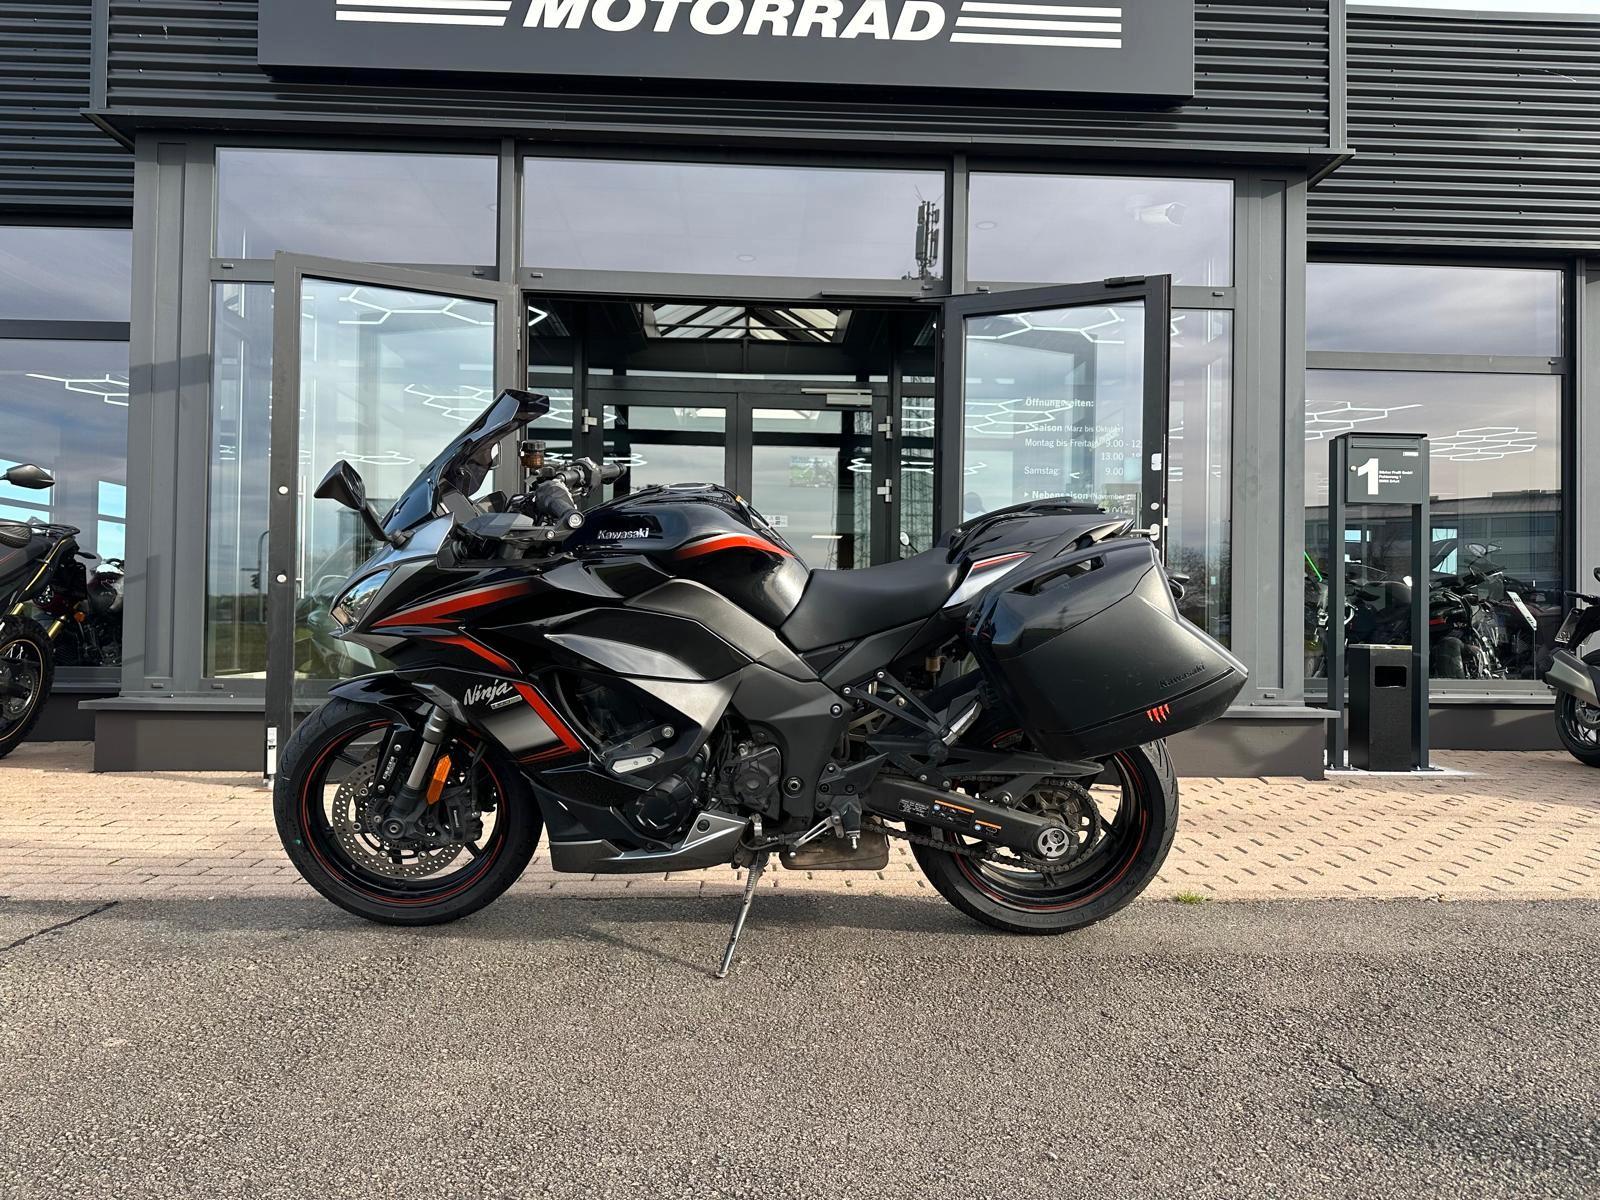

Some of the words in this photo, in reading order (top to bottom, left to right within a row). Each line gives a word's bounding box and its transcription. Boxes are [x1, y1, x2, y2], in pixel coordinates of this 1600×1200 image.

[522, 0, 947, 41] MOTORRAD
[1025, 438, 1054, 448] Montag
[1056, 438, 1068, 447] bis
[1105, 439, 1124, 448] 9.00
[1105, 467, 1124, 476] 9.00
[1357, 458, 1379, 495] 1
[597, 528, 650, 539] Kawasaki
[1160, 663, 1206, 687] Kawasaki
[463, 679, 513, 706] Ninja
